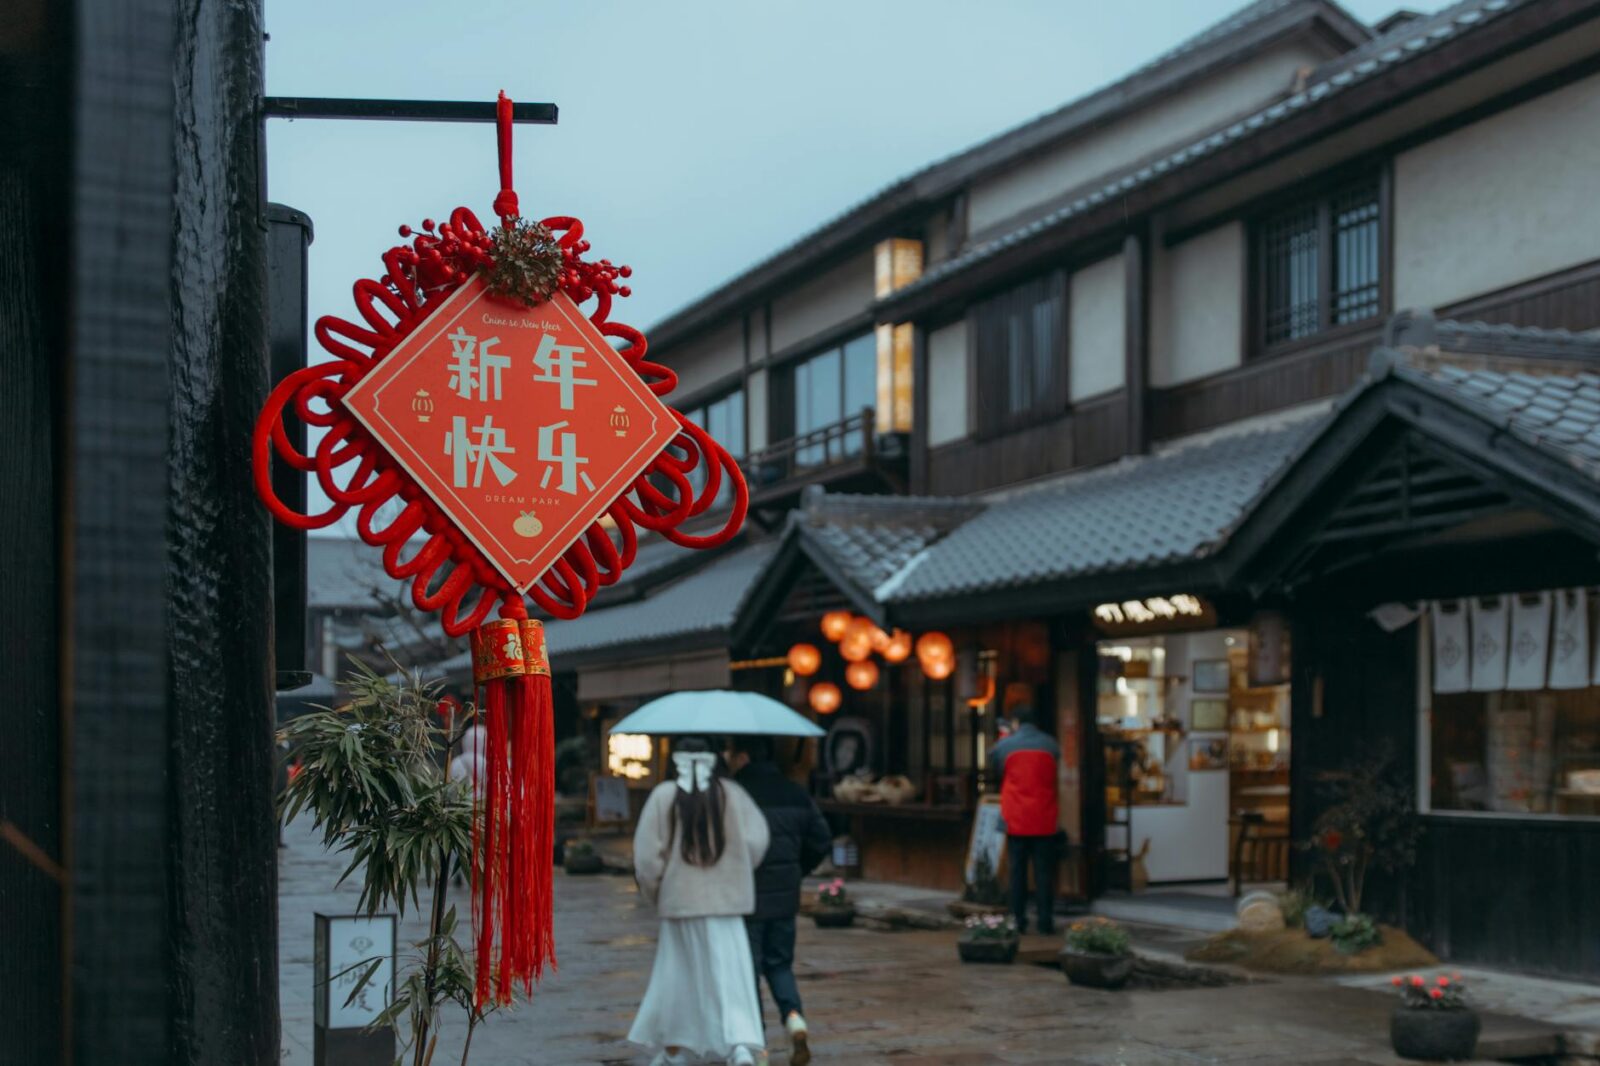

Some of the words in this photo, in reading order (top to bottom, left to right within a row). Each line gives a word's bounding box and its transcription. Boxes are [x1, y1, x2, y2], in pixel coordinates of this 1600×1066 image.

[519, 318, 540, 330] New
[447, 326, 598, 411] 新年
[444, 414, 597, 496] 快乐
[485, 494, 526, 505] DREAM
[531, 496, 561, 506] PARK
